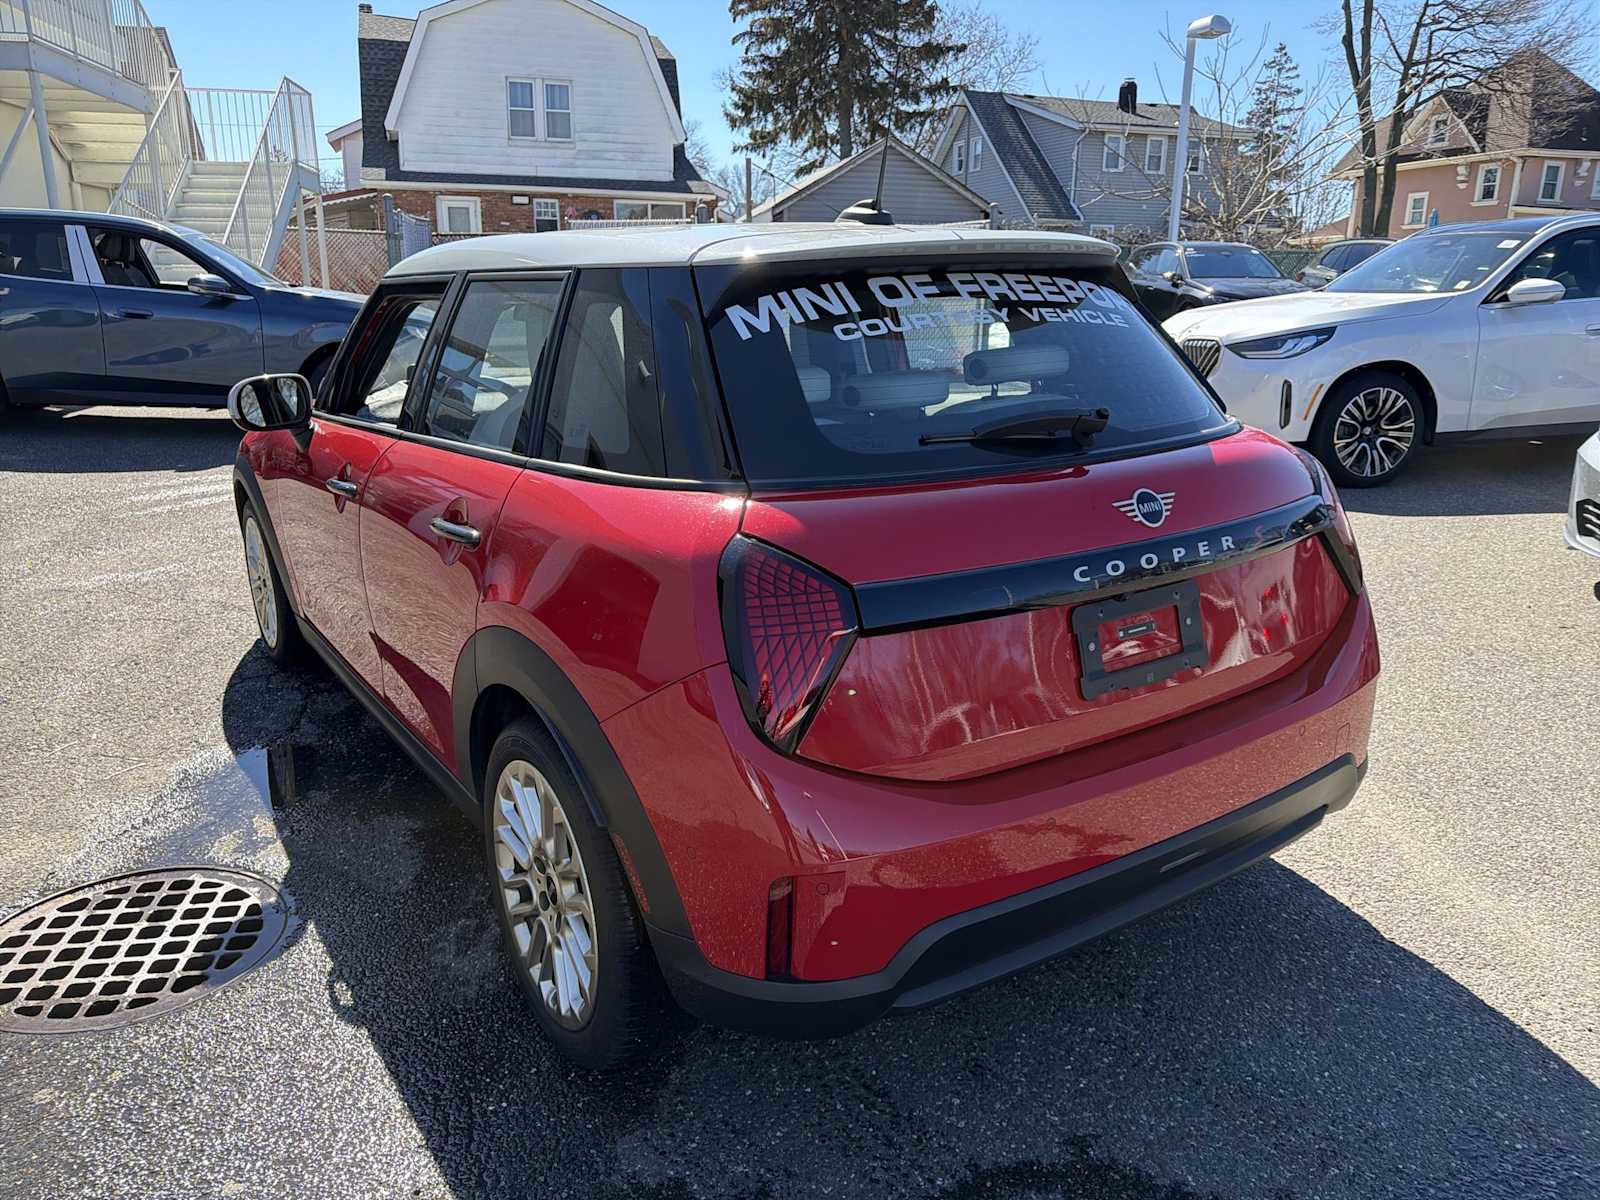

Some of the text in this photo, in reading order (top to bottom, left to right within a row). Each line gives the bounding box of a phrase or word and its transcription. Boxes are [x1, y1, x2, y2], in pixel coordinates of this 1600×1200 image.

[724, 272, 1129, 341] MINI OF FREEPOR
[833, 307, 1129, 341] COURTSY VEHICLE
[1138, 500, 1163, 514] MINI
[1073, 535, 1236, 582] COOPER
